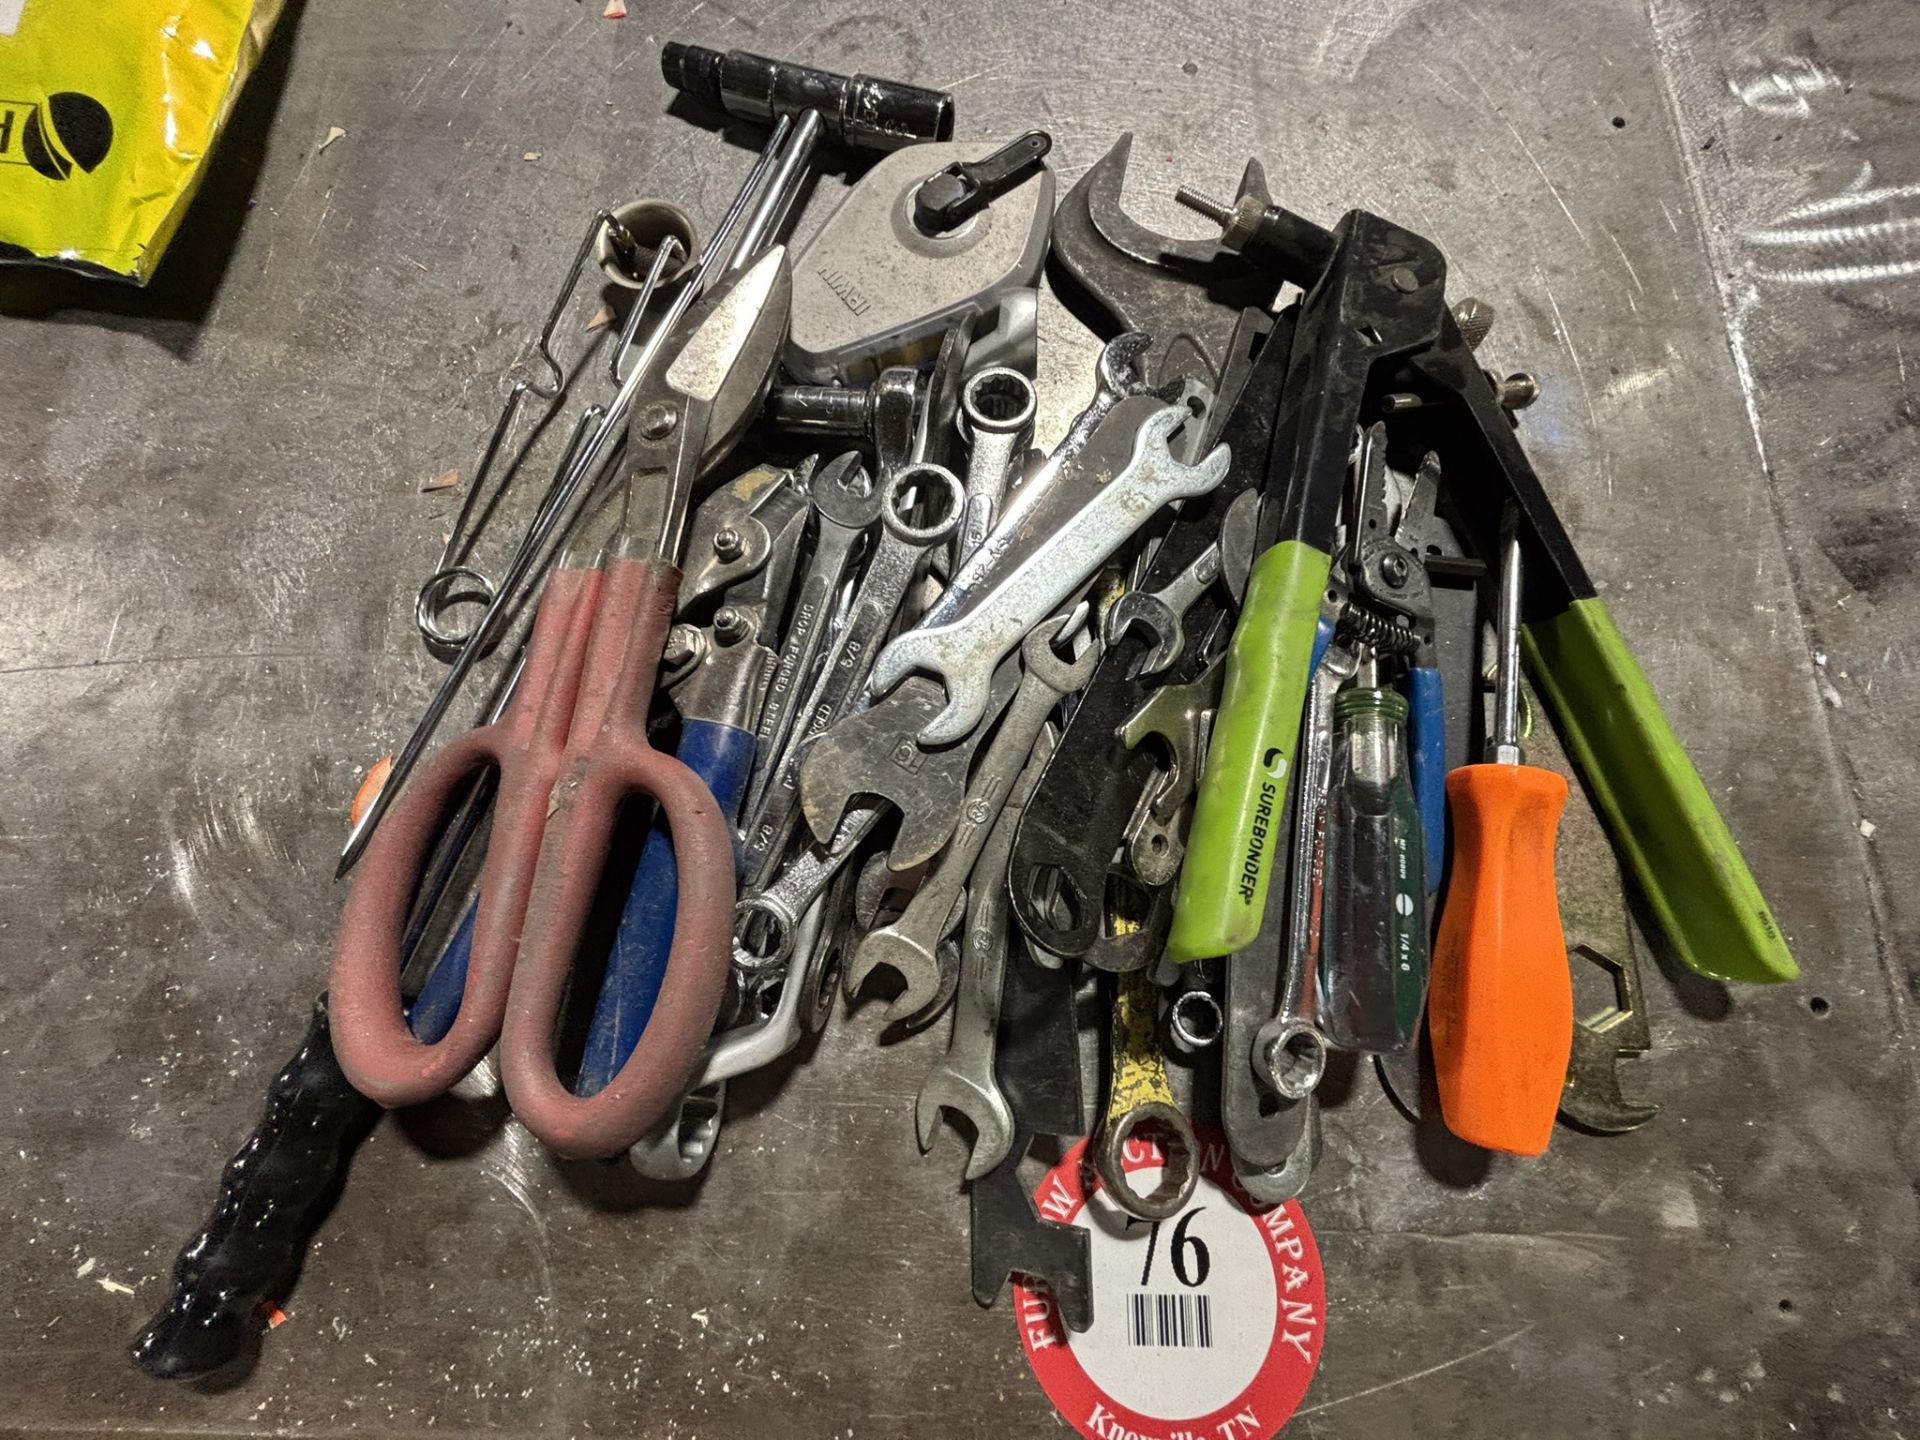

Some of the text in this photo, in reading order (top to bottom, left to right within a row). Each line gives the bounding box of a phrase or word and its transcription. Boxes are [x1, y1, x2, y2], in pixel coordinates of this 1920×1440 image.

[775, 645, 800, 693] FORGED
[840, 640, 861, 669] 5/8
[754, 825, 774, 852] 5/8
[1400, 932, 1410, 951] 1/4
[1216, 1404, 1262, 1440] TN
